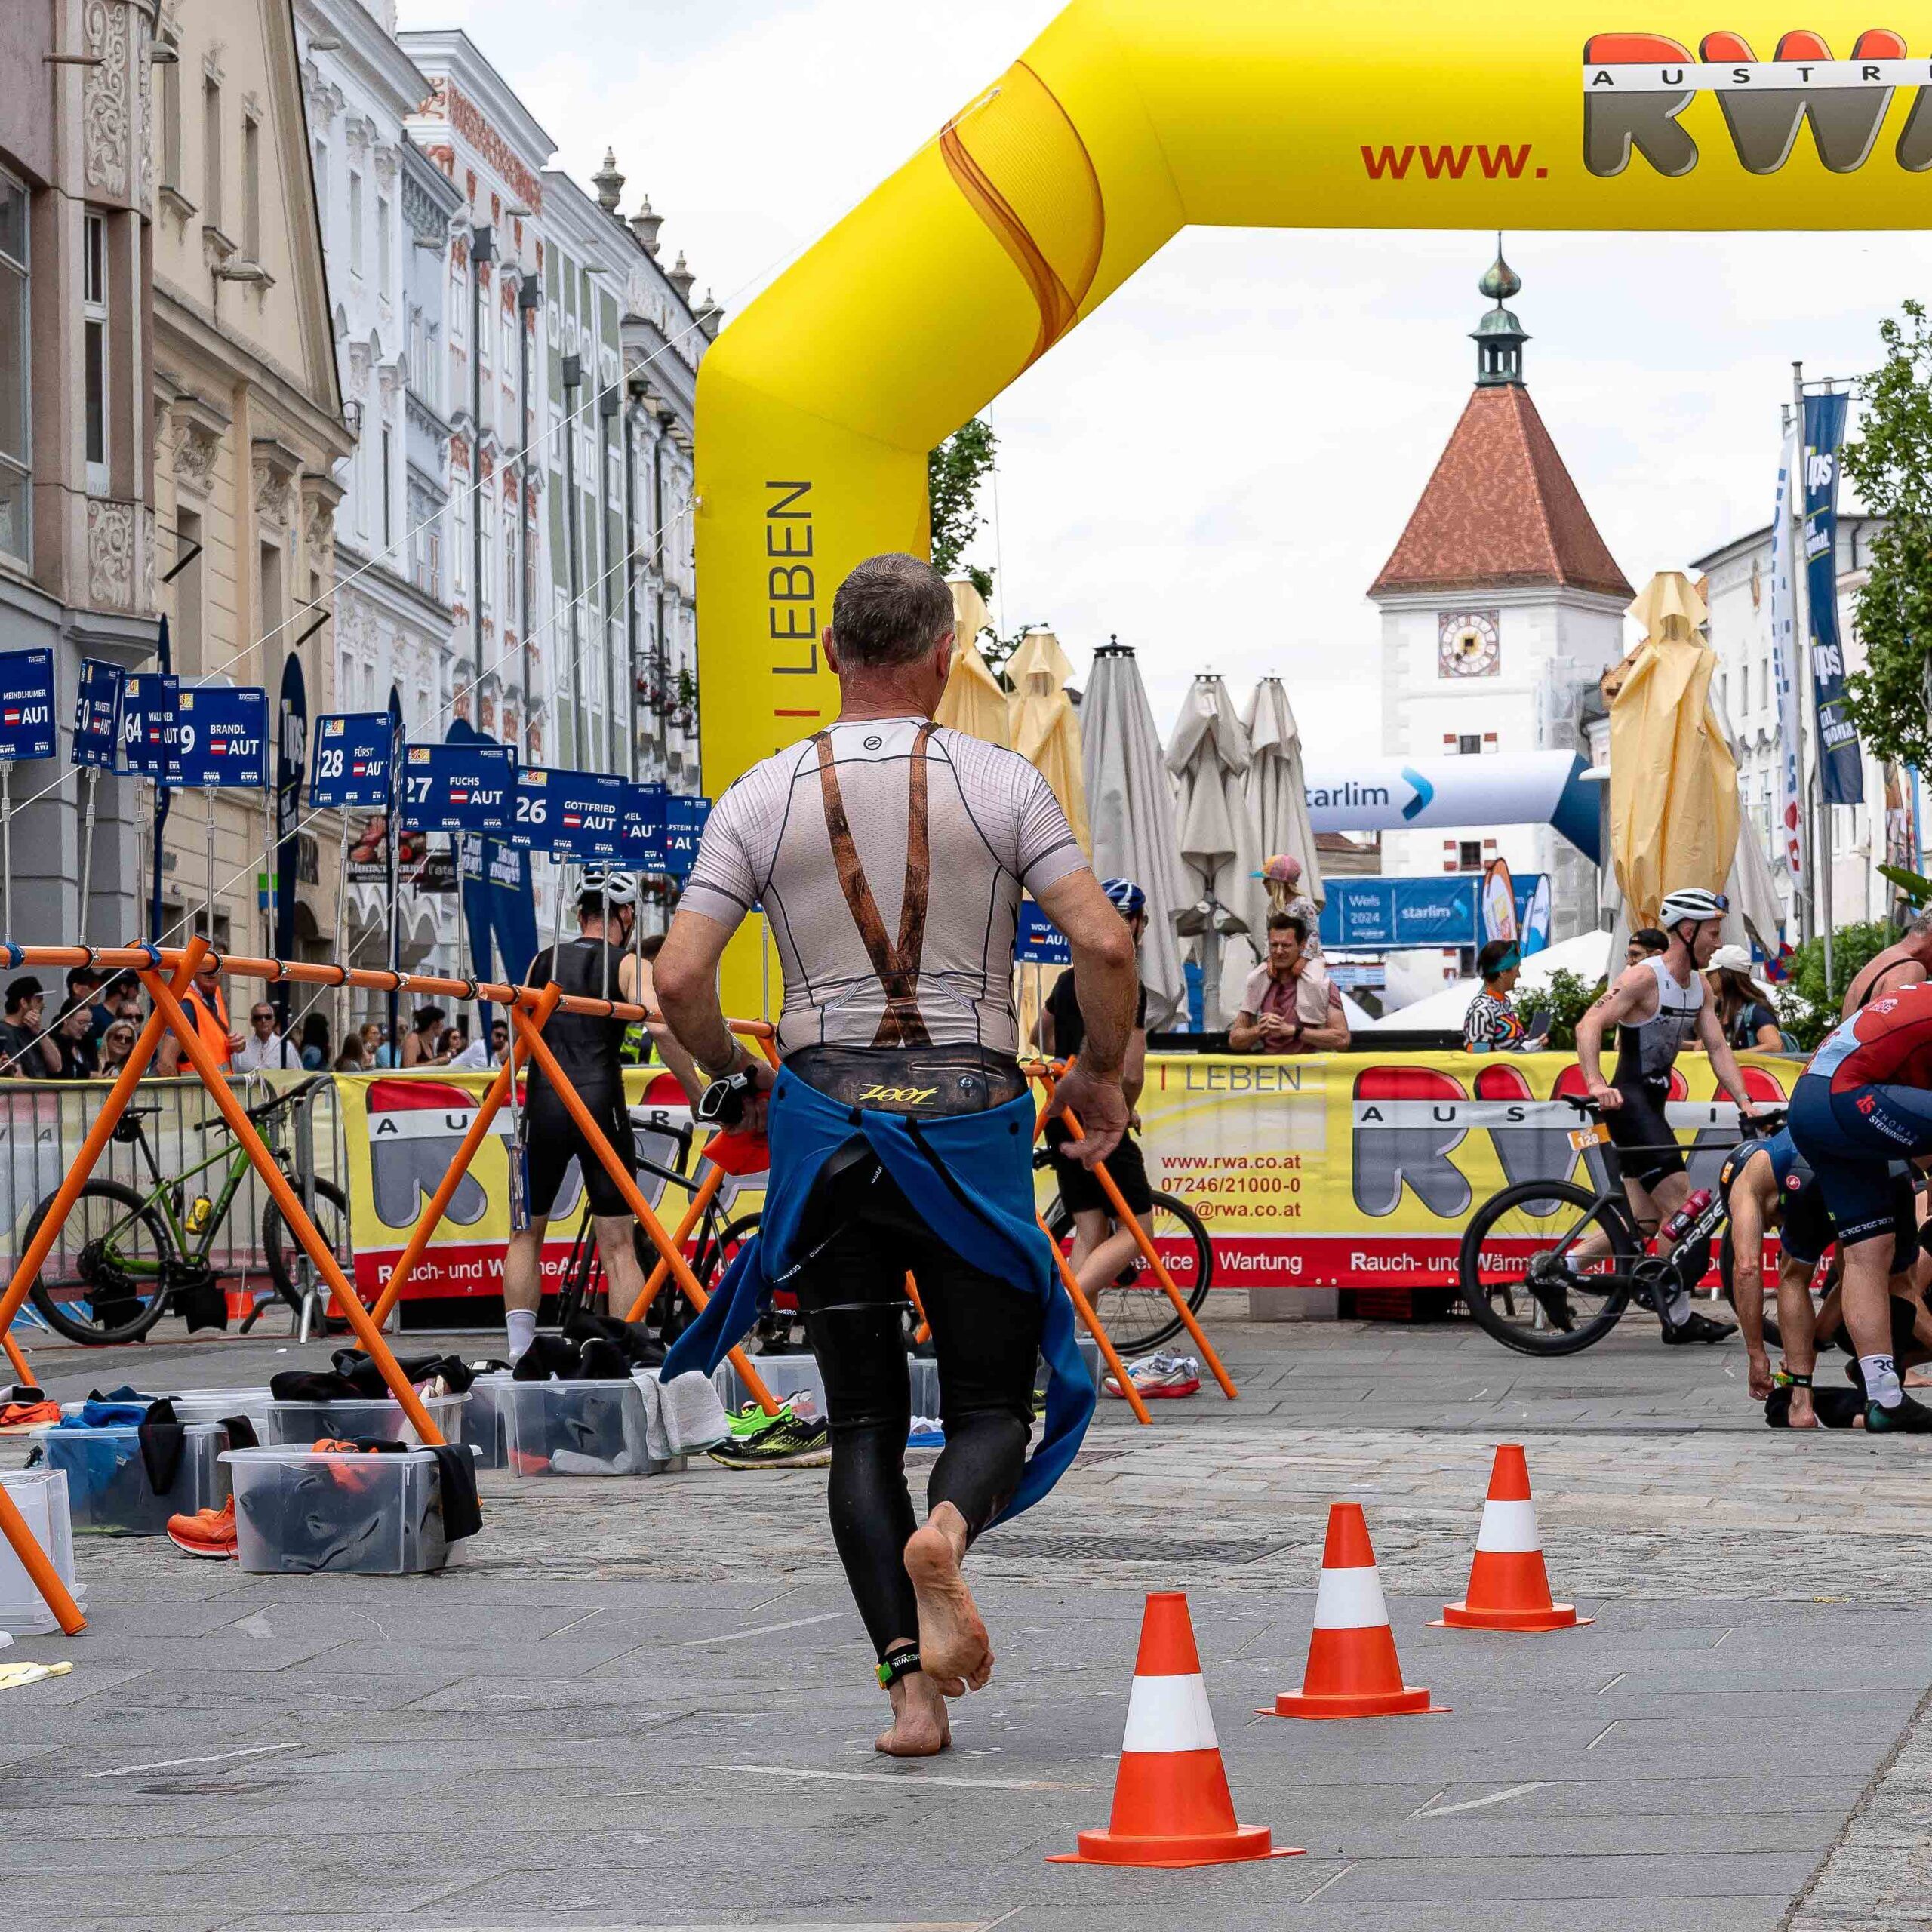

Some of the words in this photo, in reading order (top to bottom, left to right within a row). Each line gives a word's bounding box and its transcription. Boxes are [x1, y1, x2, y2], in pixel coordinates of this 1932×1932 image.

[1592, 65, 1932, 87] AUSTR
[1583, 29, 1932, 178] RW
[1359, 143, 1549, 180] www.
[764, 481, 818, 675] LEBEN
[3, 688, 47, 700] MEINDLHUMER
[22, 706, 48, 725] AUT
[125, 712, 143, 743] 64
[210, 724, 246, 734] BRANDL
[180, 724, 195, 755] 9
[229, 740, 260, 755] AUT
[354, 746, 374, 757] FÜRST
[320, 749, 344, 778] 28
[449, 777, 480, 786] FUCHS
[470, 790, 503, 804] AUT
[1306, 782, 1389, 808] tarlim
[516, 796, 547, 824] 26
[564, 801, 616, 814] GOTTFRIED
[583, 816, 617, 831] AUT
[1348, 894, 1381, 907] Wels
[1349, 911, 1381, 924] 2024
[1401, 904, 1451, 919] starlim
[1031, 923, 1052, 932] WOLF
[1186, 1064, 1302, 1092] LEBEN
[1577, 1132, 1600, 1147] 128
[1869, 1115, 1915, 1146] STEININGER
[1161, 1154, 1302, 1170] www.rwa.co.at
[1161, 1177, 1301, 1194] 07246/21000-0
[1671, 1199, 1724, 1266] ORBE
[377, 1260, 445, 1284] Ruch-
[448, 1258, 483, 1278] und
[1219, 1251, 1303, 1275] Wartung
[1350, 1252, 1423, 1272] Rauch-
